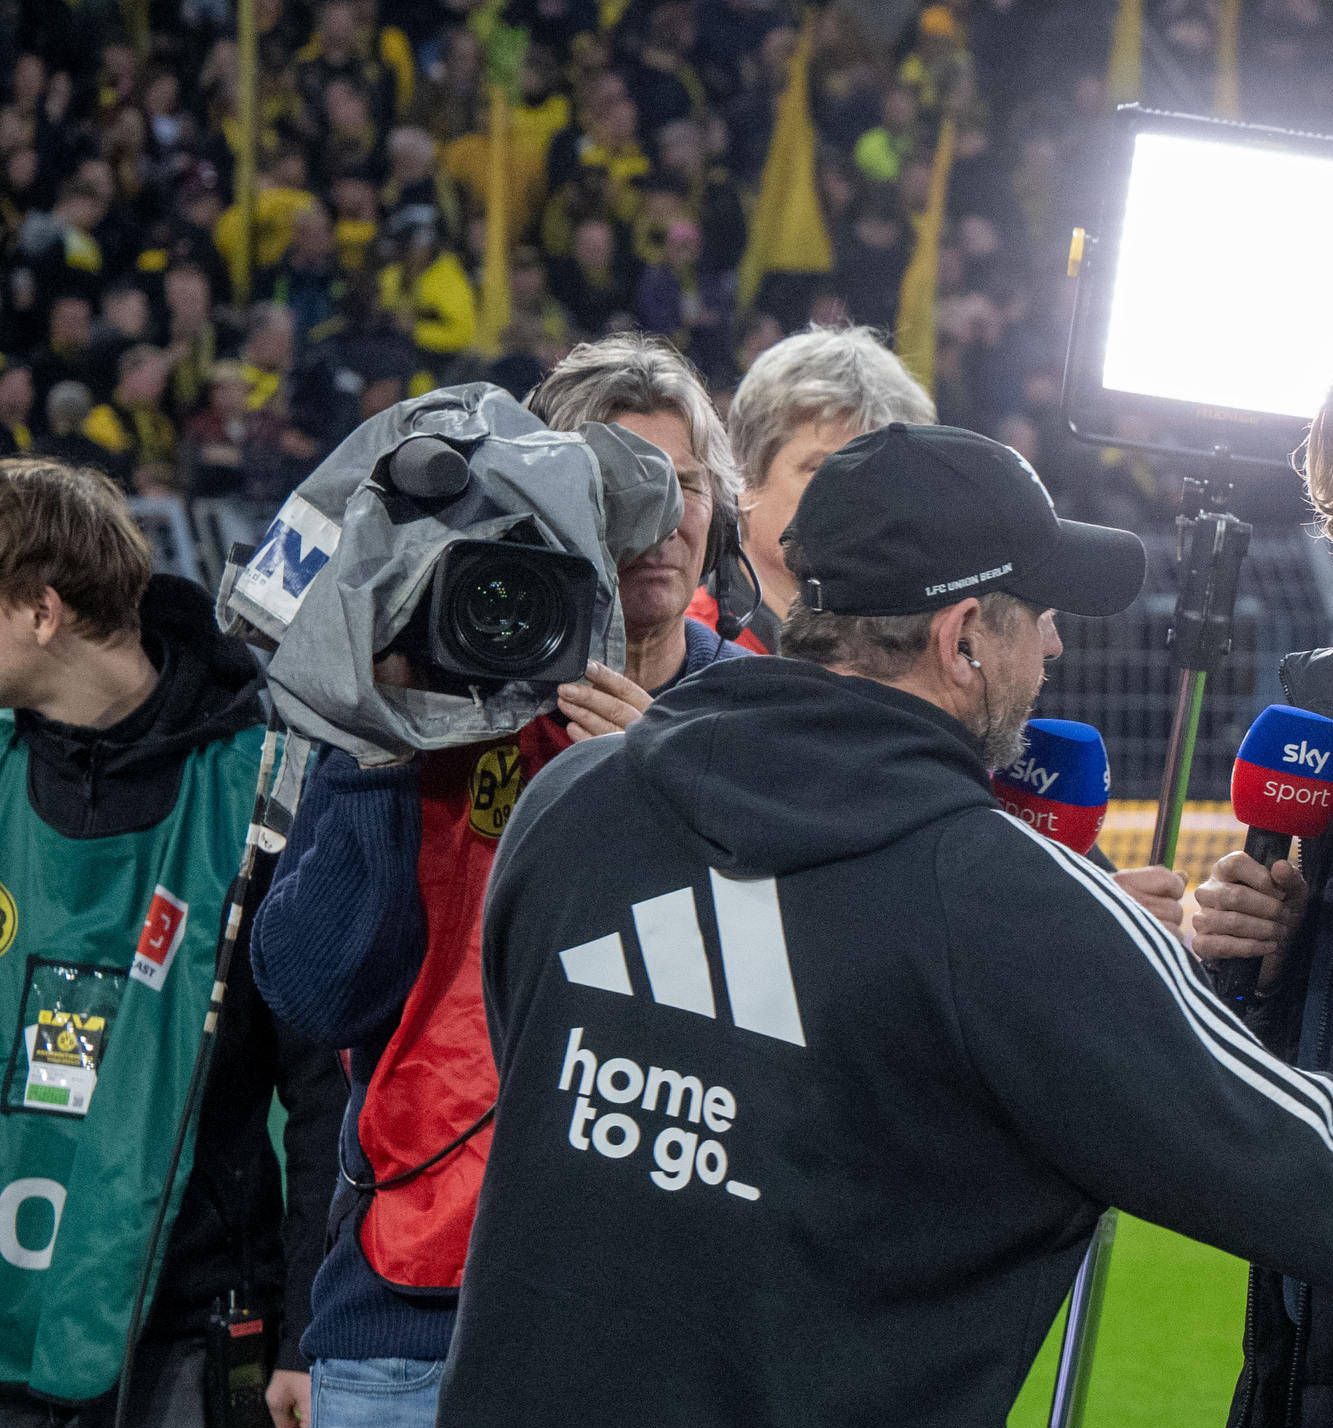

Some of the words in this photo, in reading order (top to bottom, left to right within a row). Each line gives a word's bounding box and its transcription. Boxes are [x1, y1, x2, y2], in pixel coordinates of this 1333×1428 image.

[1282, 740, 1331, 774] sky
[1009, 758, 1060, 794] sky
[1263, 780, 1331, 807] sport
[557, 1026, 737, 1134] home
[568, 1096, 641, 1159] to
